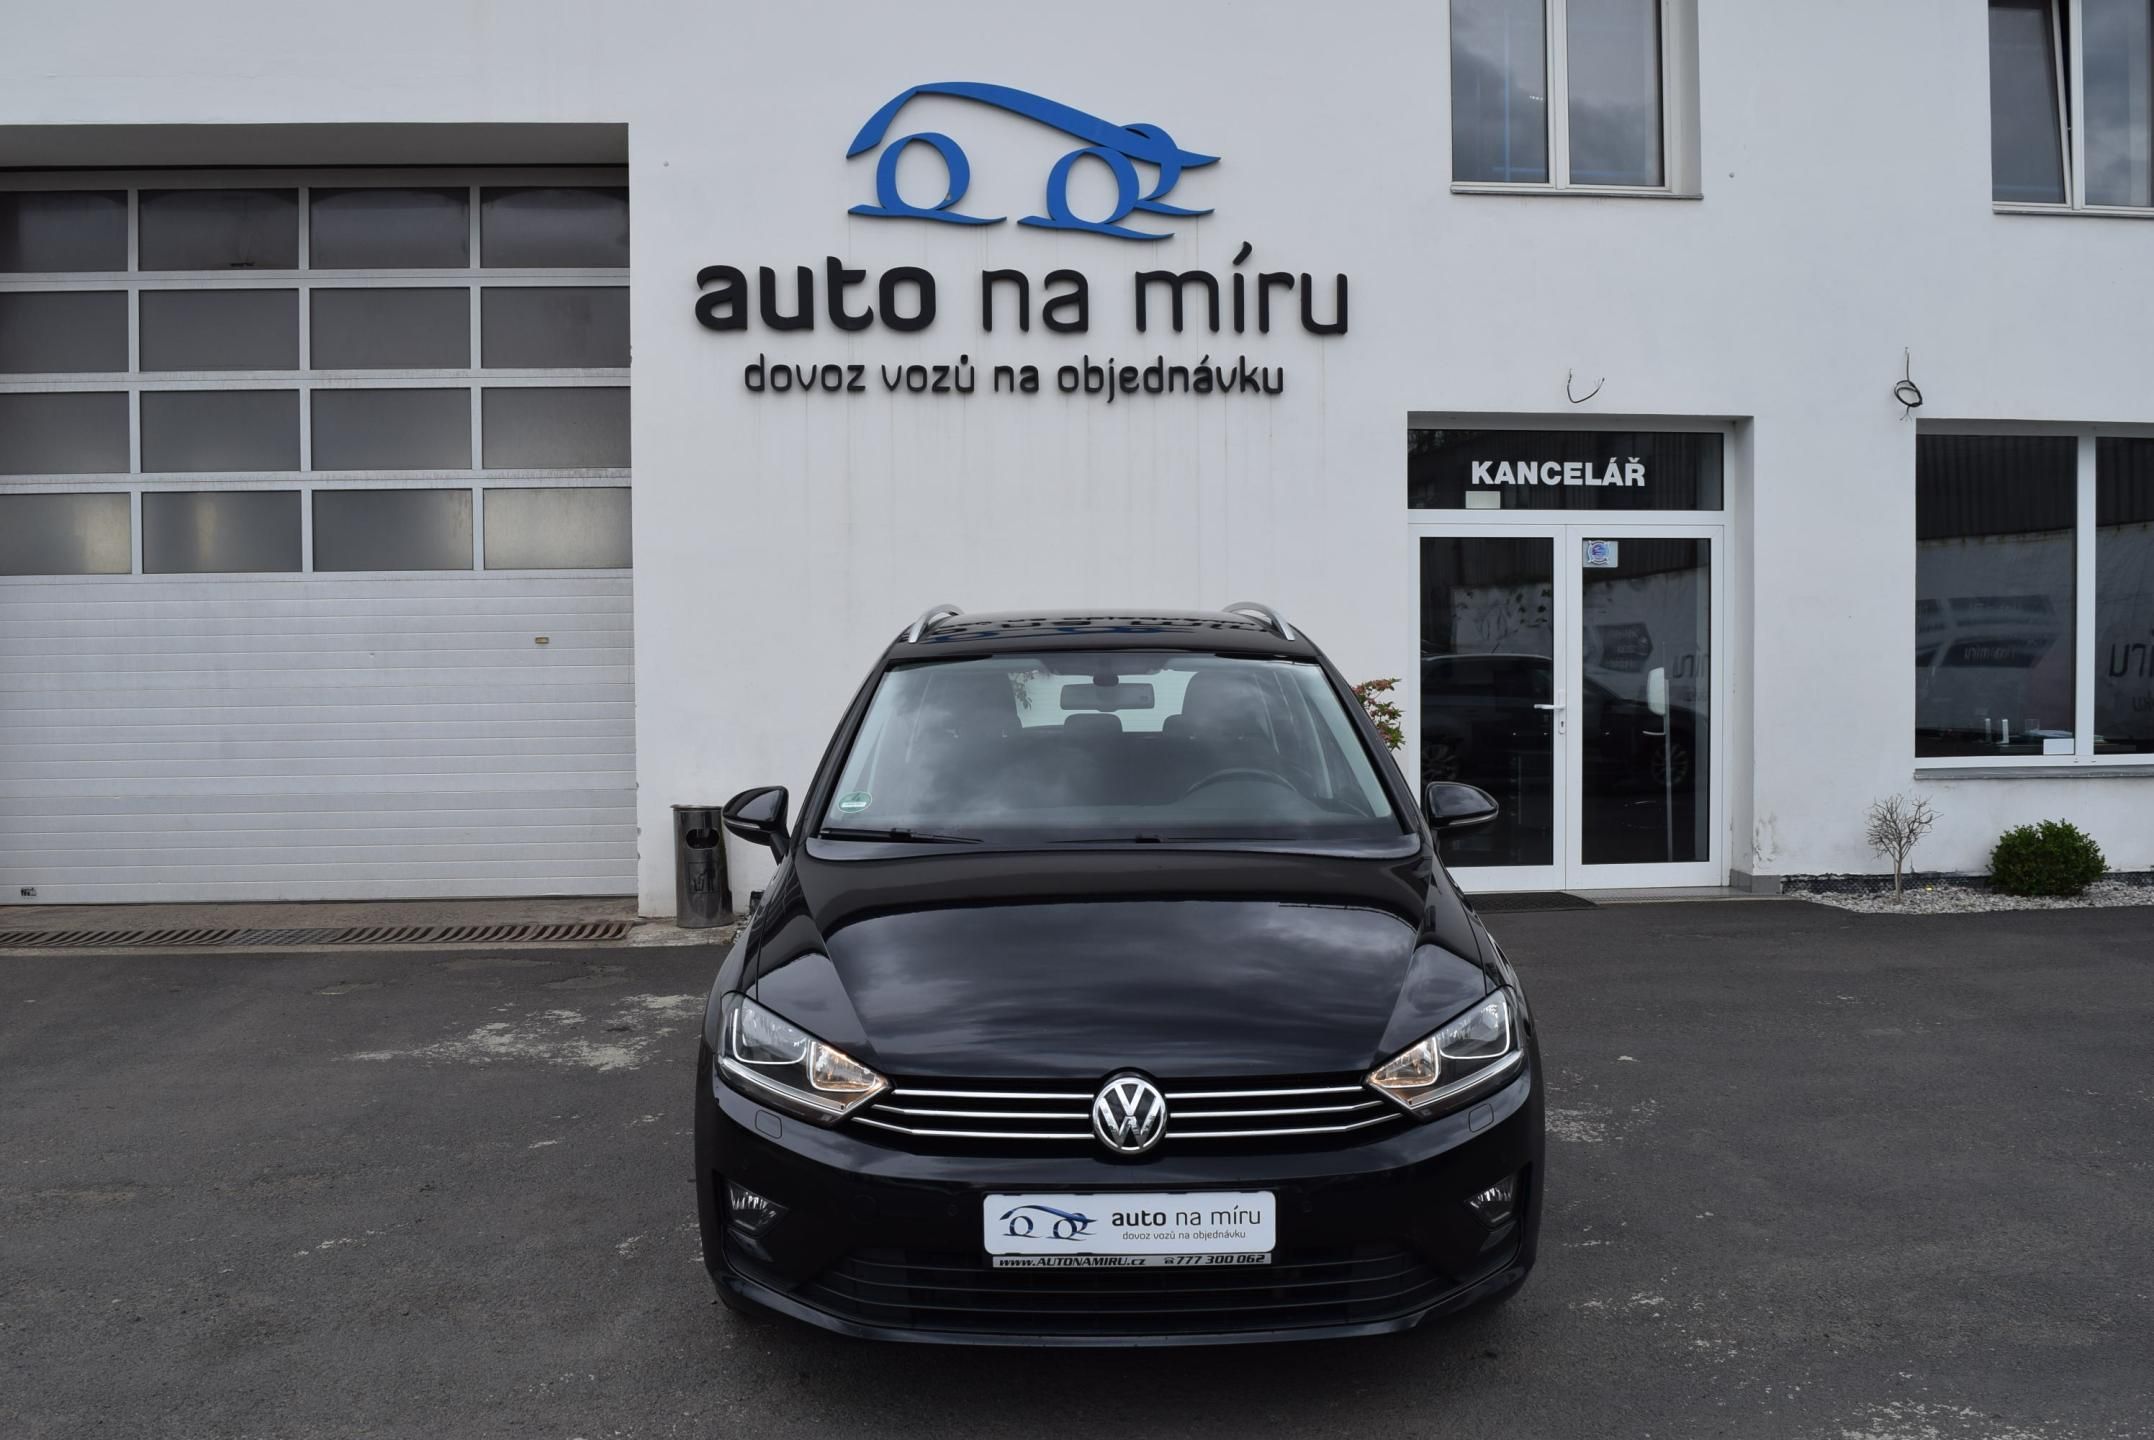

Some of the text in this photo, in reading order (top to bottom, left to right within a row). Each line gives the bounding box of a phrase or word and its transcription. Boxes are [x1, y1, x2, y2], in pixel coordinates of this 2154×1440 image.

[694, 241, 1349, 338] auto na míru
[744, 352, 1285, 404] dovoz vozů na objednávku
[1471, 456, 1646, 487] KANCELÁŘ
[1111, 1204, 1261, 1227] auto na míru
[1122, 1229, 1246, 1241] dovoz vozů na objednávku
[999, 1254, 1266, 1267] www.AUTONAMIRU.cz 777 300 062
